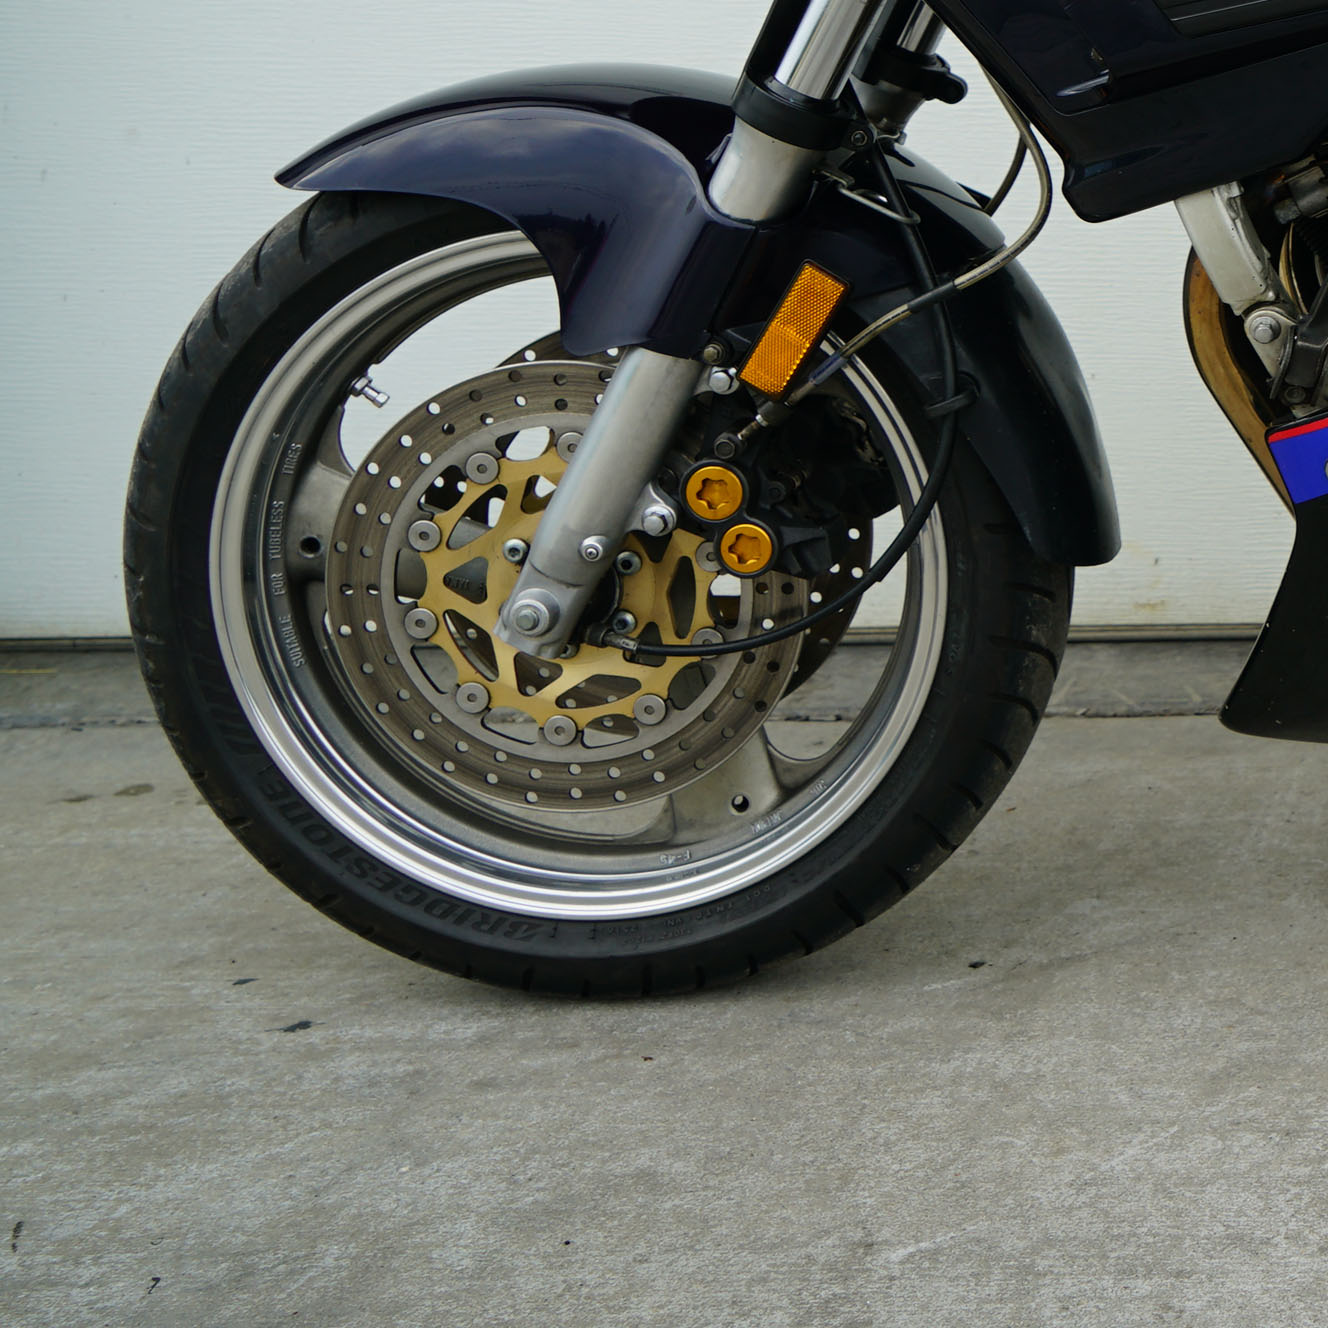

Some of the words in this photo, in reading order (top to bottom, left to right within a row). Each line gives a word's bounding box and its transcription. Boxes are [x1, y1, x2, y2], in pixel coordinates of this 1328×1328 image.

[281, 442, 303, 475] TIRES
[268, 500, 285, 561] TUBELESS
[270, 572, 286, 596] FOR
[278, 614, 305, 668] SUITABLE
[257, 772, 541, 949] BRIDGESTONE
